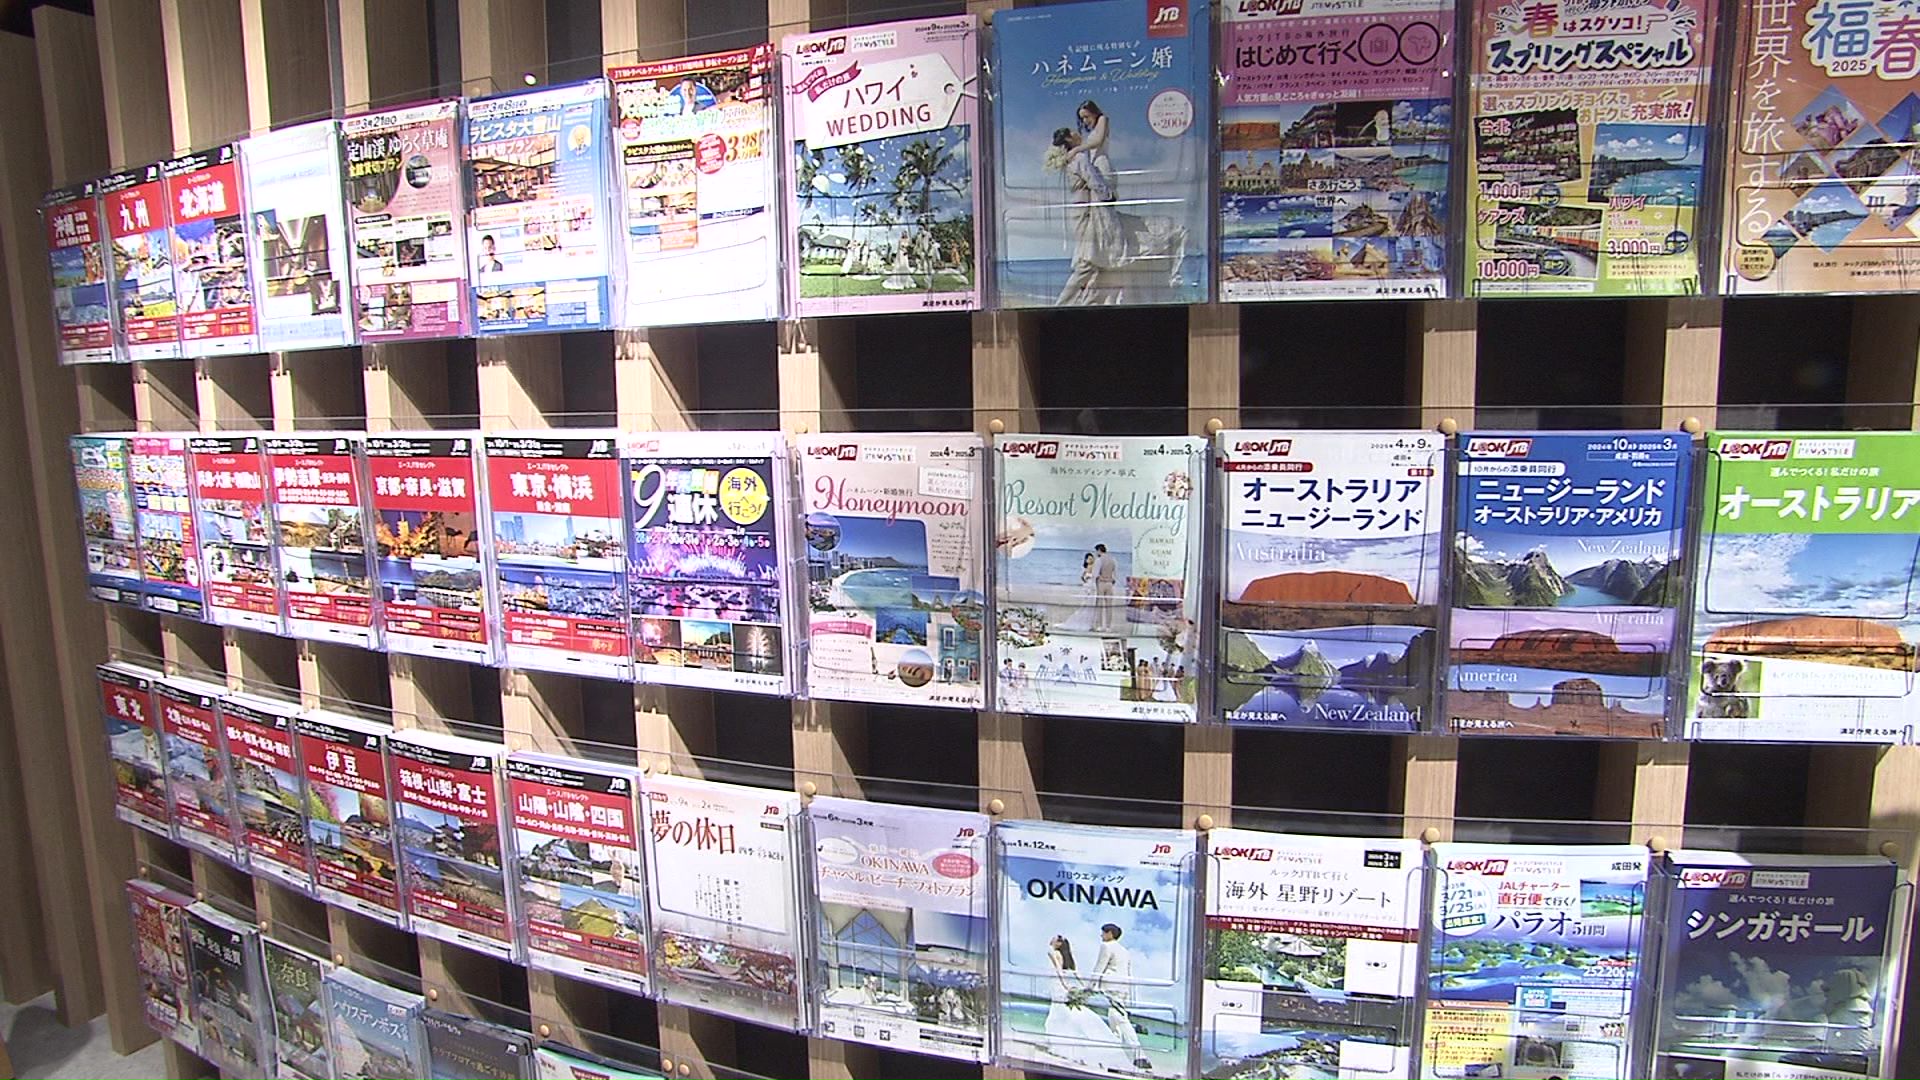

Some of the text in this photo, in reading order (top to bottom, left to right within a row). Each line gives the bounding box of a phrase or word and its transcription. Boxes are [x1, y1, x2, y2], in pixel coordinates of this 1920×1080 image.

[1154, 7, 1180, 24] JTB
[1523, 2, 1559, 38] 春
[796, 36, 847, 56] LOOK JTB
[1808, 0, 1920, 73] 福 春
[1031, 46, 1174, 76] ハネムーン婚
[1236, 39, 1358, 69] はじめて行く
[1490, 38, 1688, 71] スプリングスペシャル
[1832, 59, 1868, 73] 2025
[844, 76, 906, 109] ハワイ
[1482, 92, 1628, 113] 選べるスプリングチョイスで
[827, 103, 932, 137] WEDDING
[1578, 102, 1692, 124] おトクに充実旅!
[1740, 0, 1797, 233] 世界を旅する
[1478, 119, 1511, 137] 台北
[179, 181, 227, 219] 北海道
[1316, 196, 1349, 207] 世界へ
[1478, 182, 1531, 200] 1,000円
[1608, 195, 1646, 211] ハワイ
[120, 199, 150, 232] 九州
[1477, 206, 1527, 226] ケアンズ
[1607, 239, 1663, 256] 3,000円
[1476, 260, 1539, 280] 10,000円
[807, 445, 858, 461] LOOK JTB
[1002, 441, 1060, 459] LOOK JTB
[1235, 439, 1293, 456] LOOK JTB
[1471, 439, 1531, 456] LOOK JTB
[1721, 440, 1791, 460] LOOK JTB
[375, 476, 466, 499] 京都・奈良・滋賀
[509, 471, 595, 502] 東京・横浜
[727, 476, 758, 492] 海外
[1243, 477, 1422, 503] オーストラリア
[1475, 477, 1667, 505] ニュージーランド
[634, 463, 667, 530] 9
[813, 474, 969, 528] Honeymoon
[1718, 485, 1920, 522] オーストラリア
[667, 493, 719, 526] 連休
[1004, 479, 1186, 537] Resort Wedding
[1241, 506, 1423, 532] ニュージーランド
[1474, 505, 1663, 528] オーストラリア・アメリカ
[1236, 542, 1327, 563] Australia
[1453, 670, 1519, 684] America
[1314, 703, 1423, 724] New Zealand
[324, 750, 360, 777] 伊豆
[399, 768, 487, 805] 箱根・山梨・富士
[518, 792, 625, 830] 山陽・山陰・四国
[763, 805, 780, 816] JTB
[650, 809, 736, 855] 夢の休日
[956, 827, 975, 838] JTB
[1151, 843, 1173, 855] JTB
[1214, 846, 1274, 862] LOOK JTB
[860, 854, 931, 877] OKINAWA
[1446, 859, 1509, 876] LOOK JTB
[1610, 861, 1643, 872] 成田発
[1055, 870, 1127, 885] JTBウエディング
[1497, 881, 1572, 893] JALチャーター
[1683, 871, 1748, 887] LOOK JTB
[1026, 878, 1160, 911] OKINAWA
[1225, 880, 1392, 909] 海外 星野リゾート
[1497, 892, 1577, 907] 直行便で行く!
[1491, 910, 1607, 937] パラオ 5日間
[1686, 909, 1875, 944] シンガポール
[280, 962, 311, 992] 奈良
